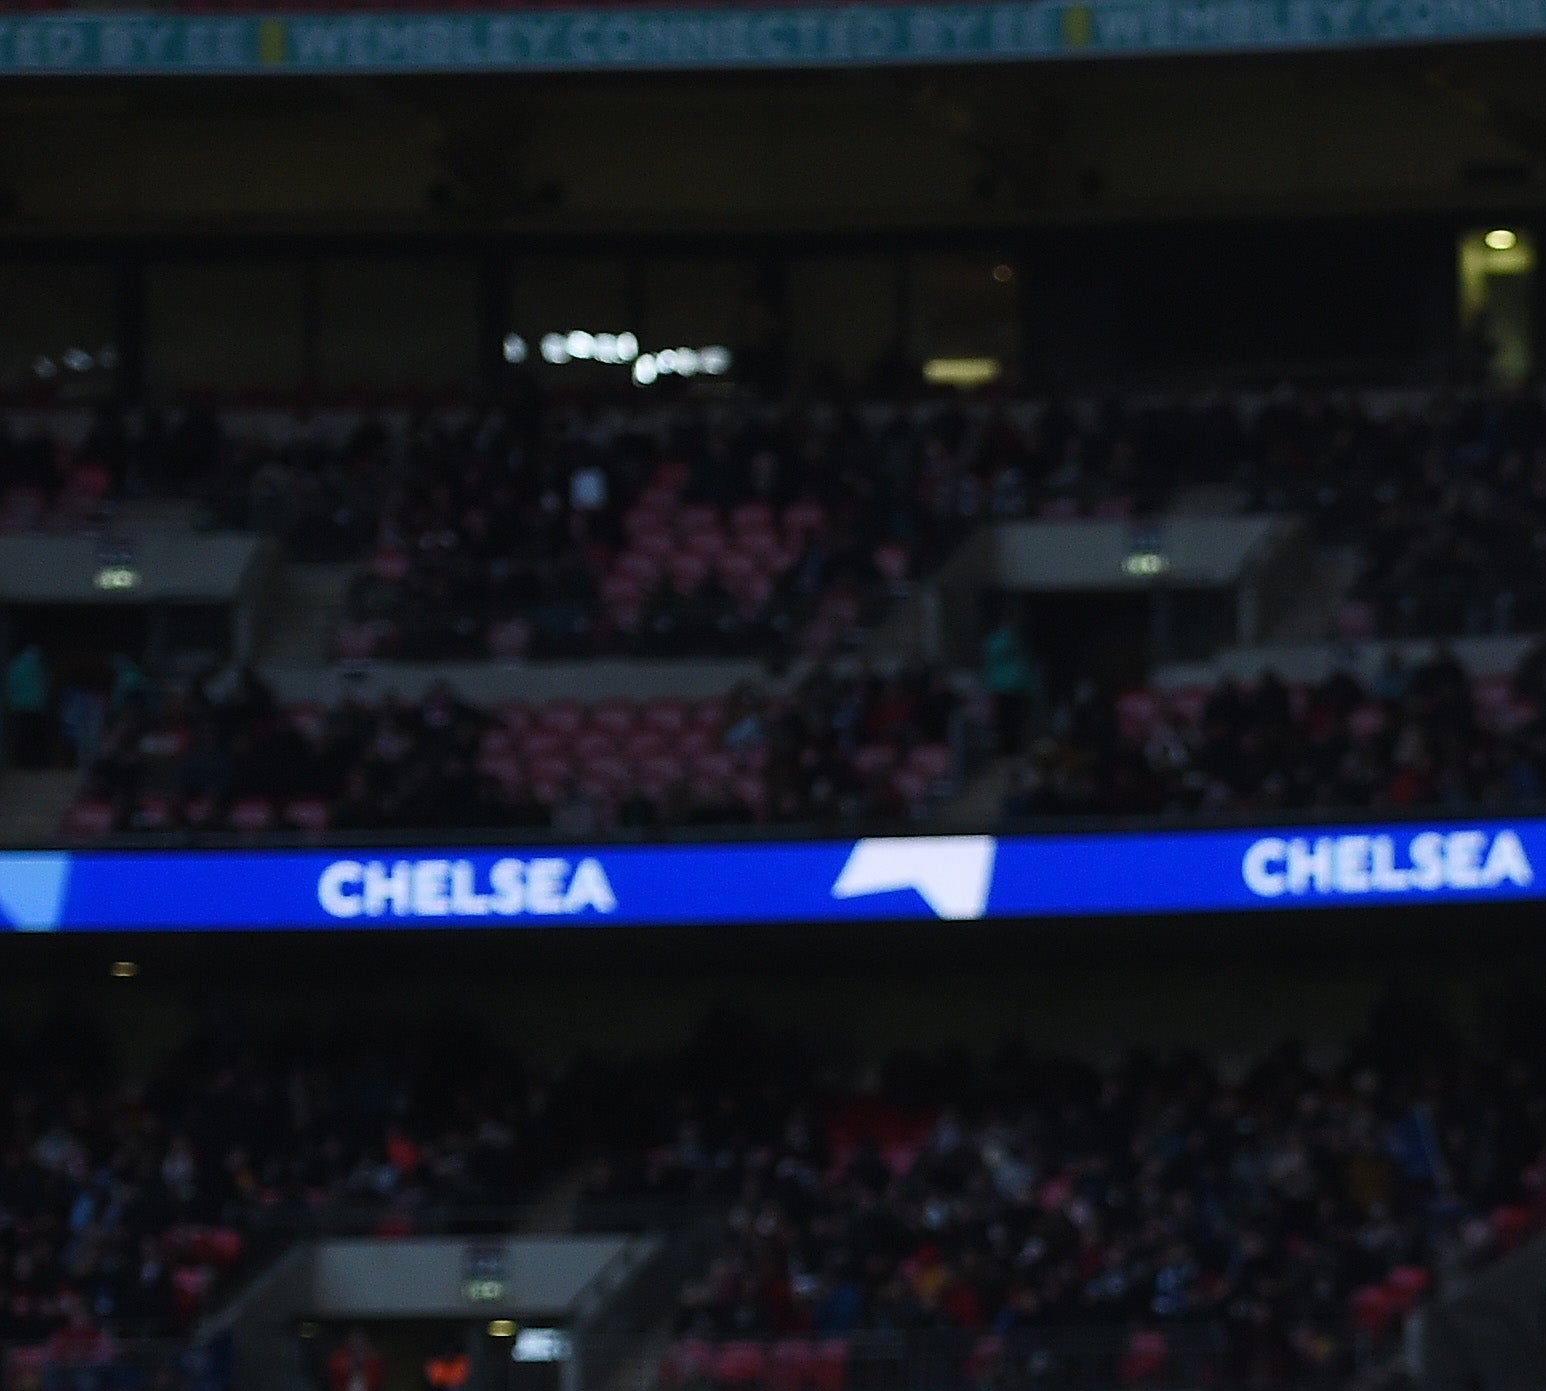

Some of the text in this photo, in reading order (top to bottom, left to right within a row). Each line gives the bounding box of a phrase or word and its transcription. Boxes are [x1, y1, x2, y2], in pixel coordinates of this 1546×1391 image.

[296, 18, 562, 67] WEMBLEY
[568, 12, 895, 61] CONNECTED
[318, 857, 616, 917] CHELSEA
[1242, 830, 1533, 896] CHELSEA
